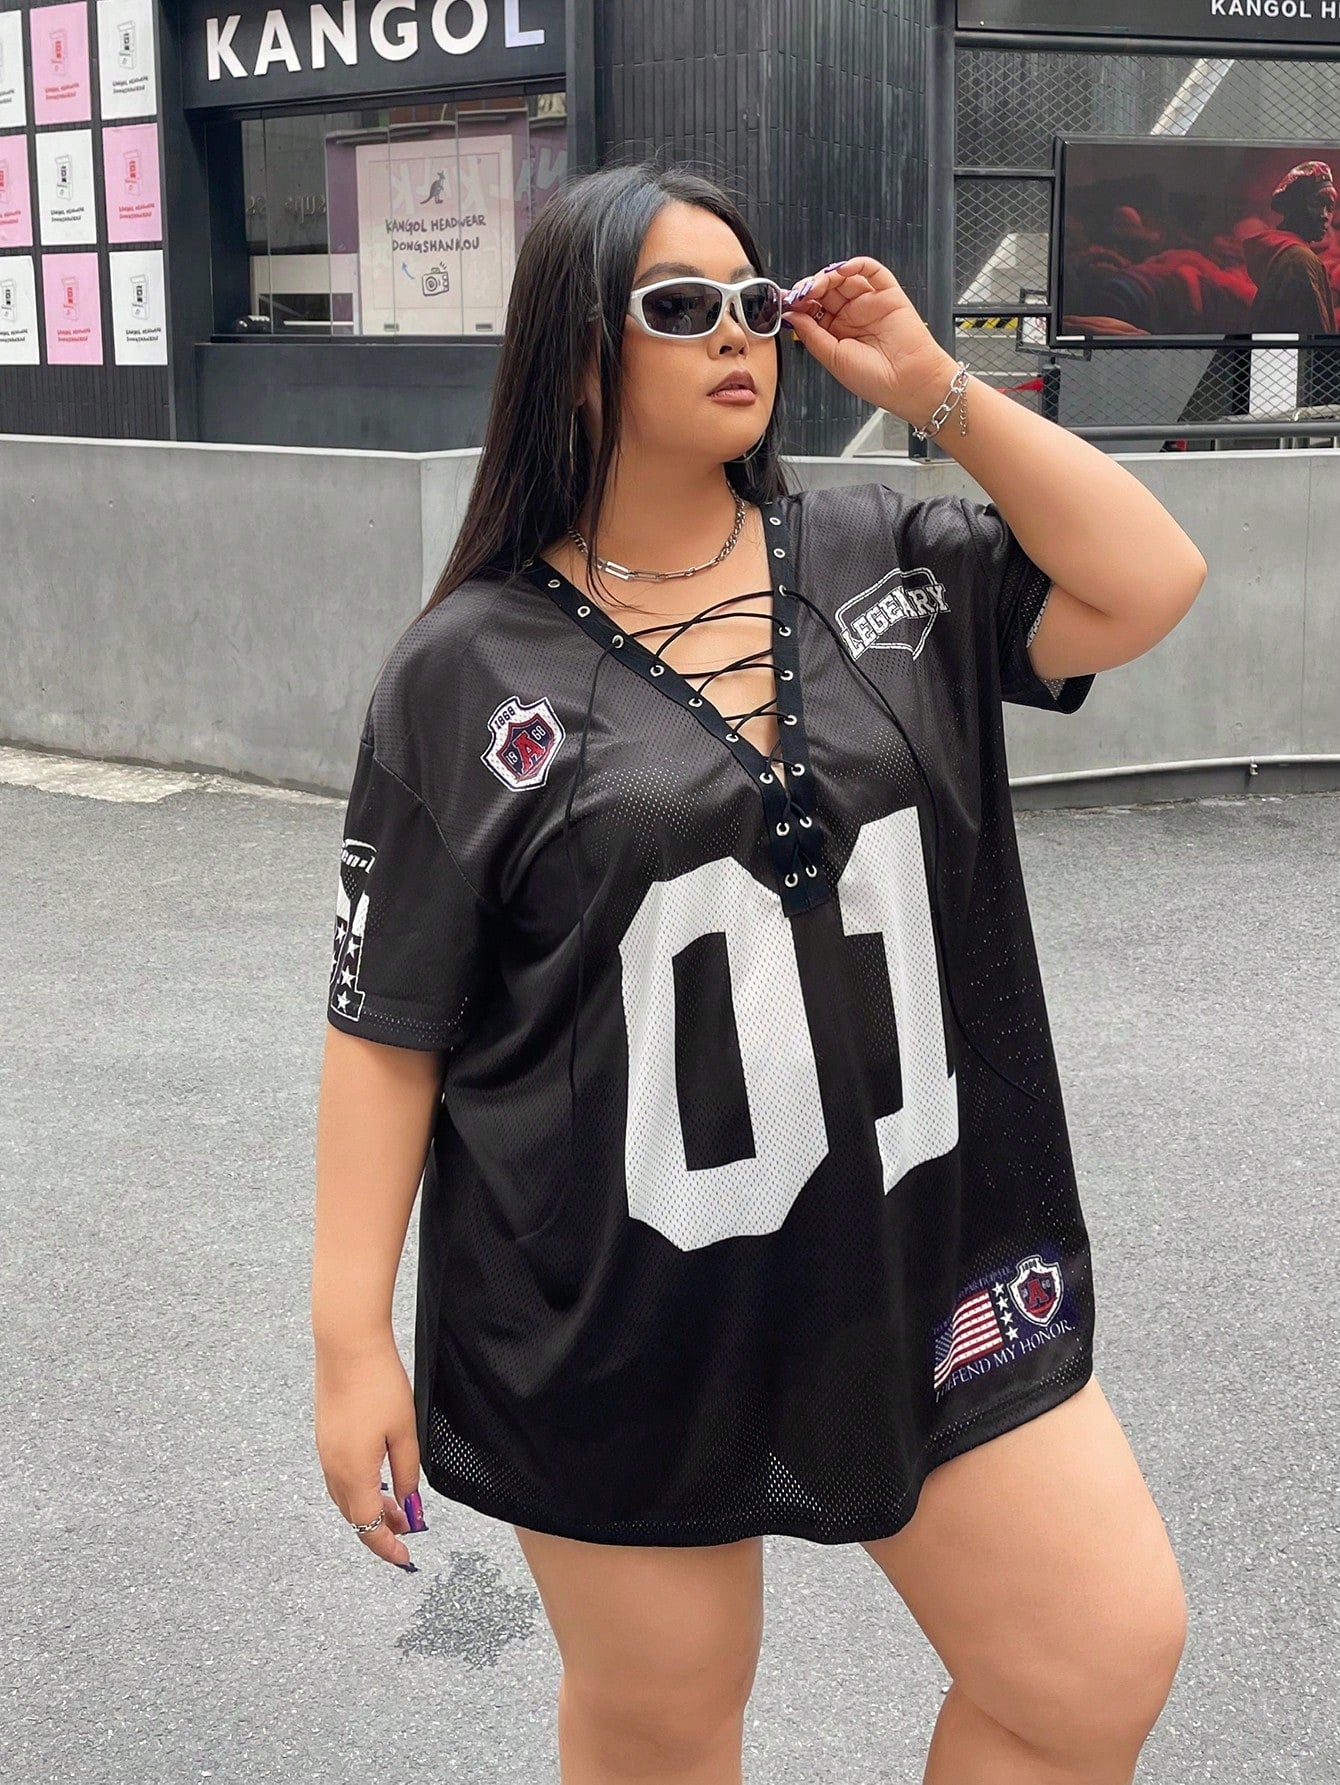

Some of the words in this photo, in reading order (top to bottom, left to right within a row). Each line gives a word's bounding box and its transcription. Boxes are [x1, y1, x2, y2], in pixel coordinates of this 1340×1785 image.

[1210, 0, 1312, 18] KANGOL
[1320, 1, 1340, 19] H
[206, 0, 546, 81] KANGOL
[385, 218, 427, 235] KANGOL
[618, 806, 960, 1252] 01
[993, 1343, 1016, 1368] MY
